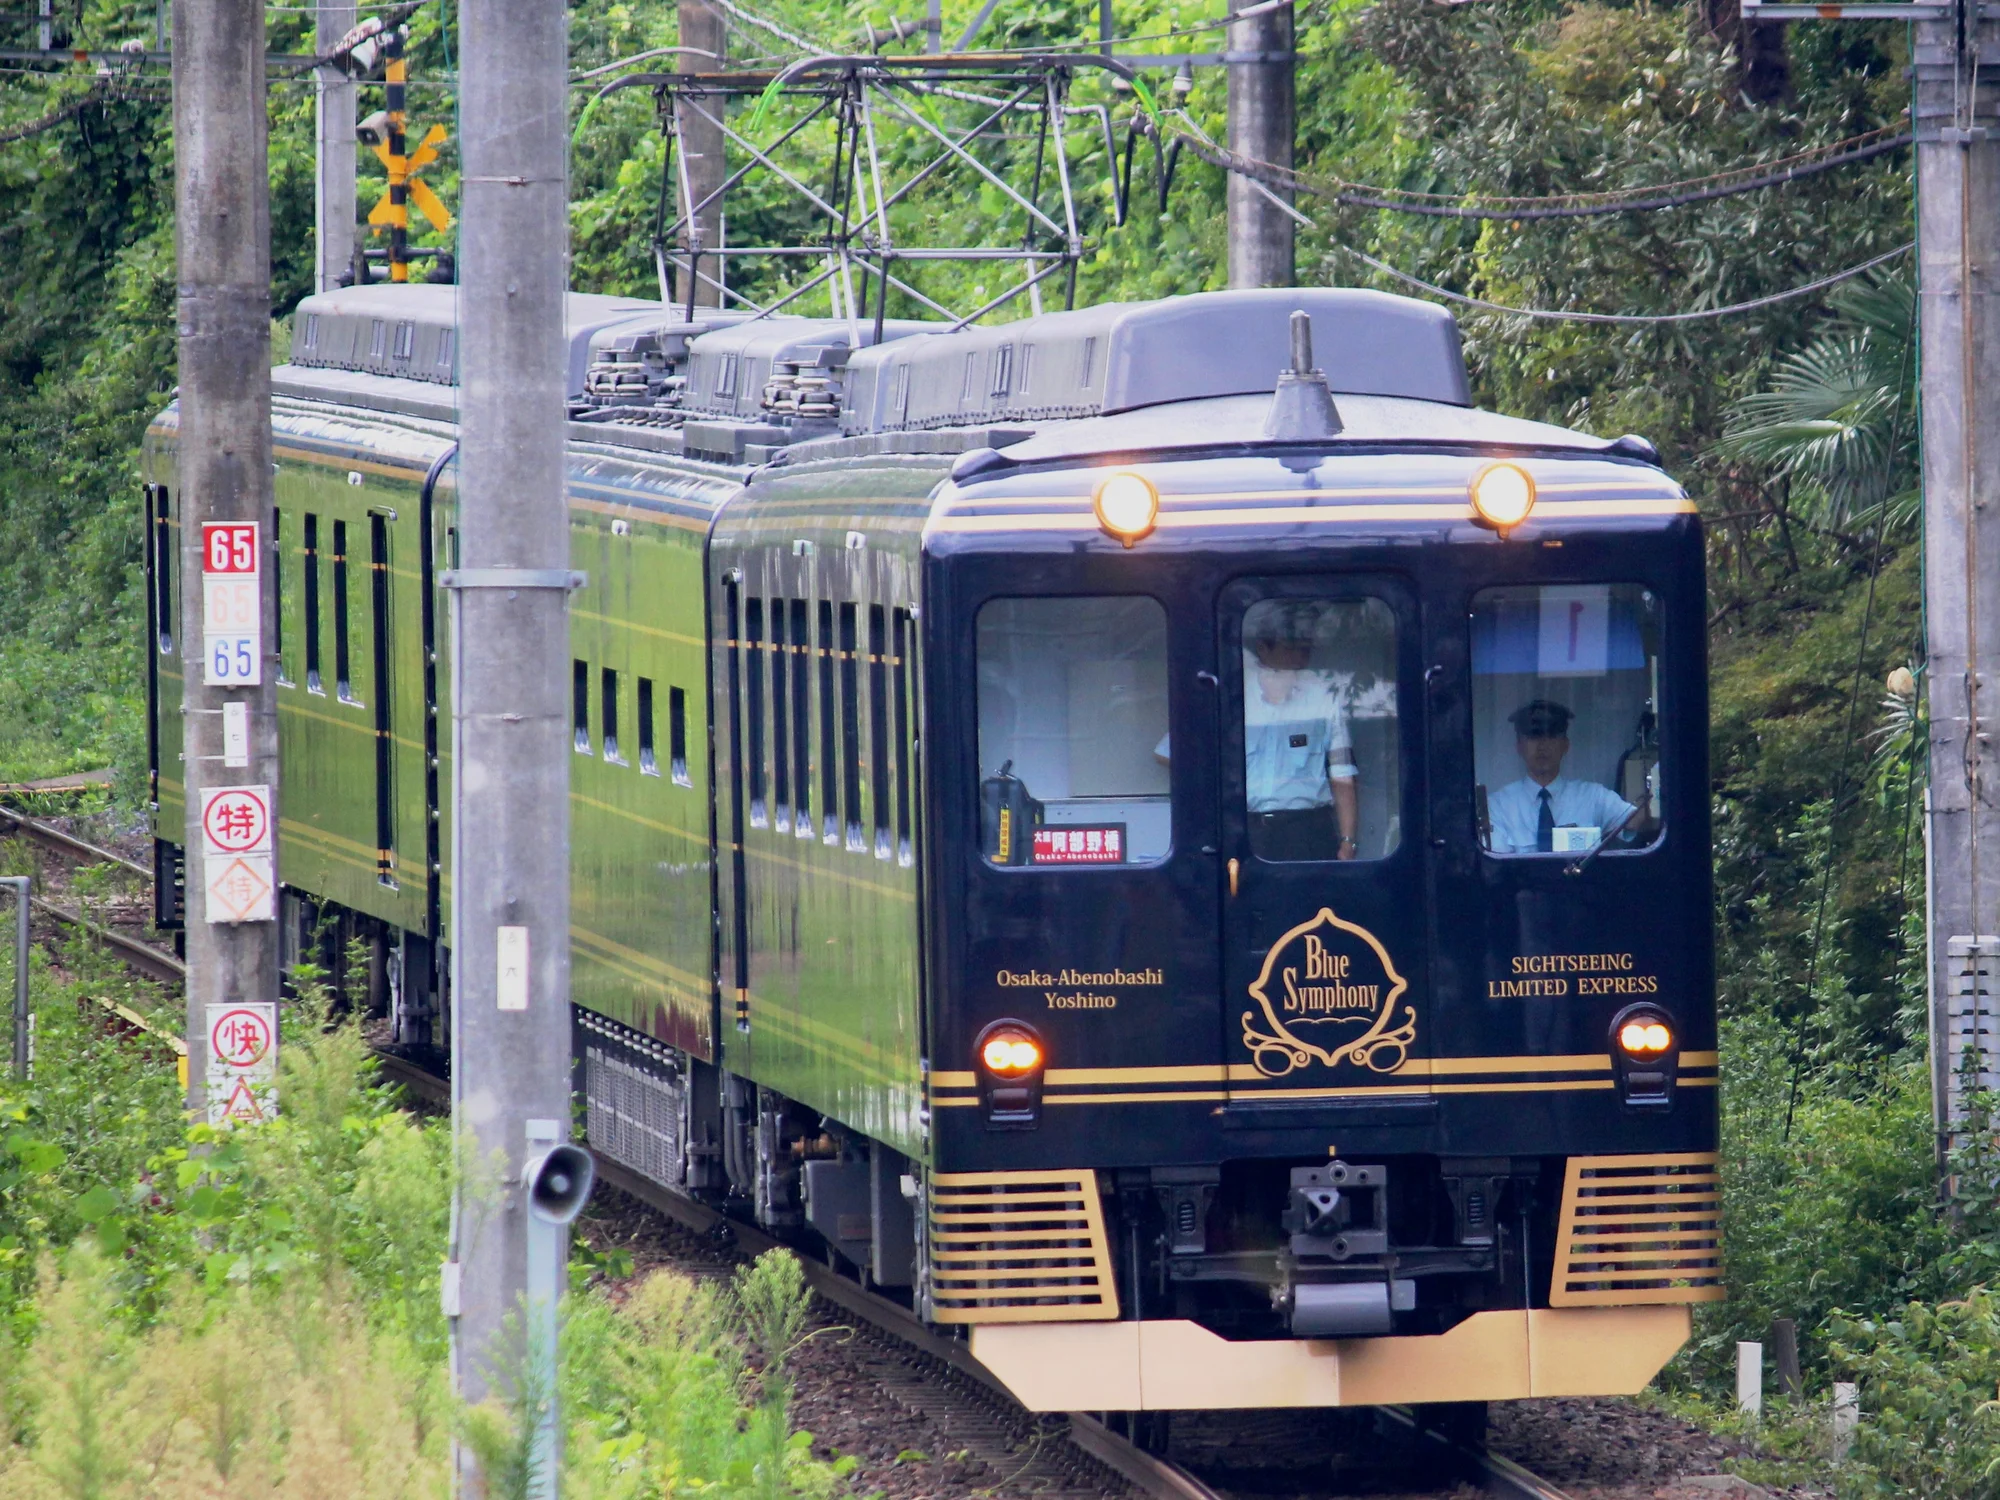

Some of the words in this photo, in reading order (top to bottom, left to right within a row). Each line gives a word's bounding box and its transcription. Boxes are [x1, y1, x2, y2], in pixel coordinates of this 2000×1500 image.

[210, 529, 251, 570] 65
[212, 585, 250, 624] 65
[214, 639, 251, 678] 65
[216, 803, 255, 840] 特
[226, 875, 252, 902] 特
[1304, 934, 1350, 979] Blue
[1511, 953, 1633, 974] SIGHTSEEING
[996, 968, 1163, 987] Osaka-Abenobashi
[1282, 966, 1379, 1014] Symphony
[1488, 978, 1568, 998] LIMITED
[1577, 976, 1658, 995] EXPRESS
[1044, 992, 1116, 1009] Yoshino
[223, 1020, 260, 1056] 快
